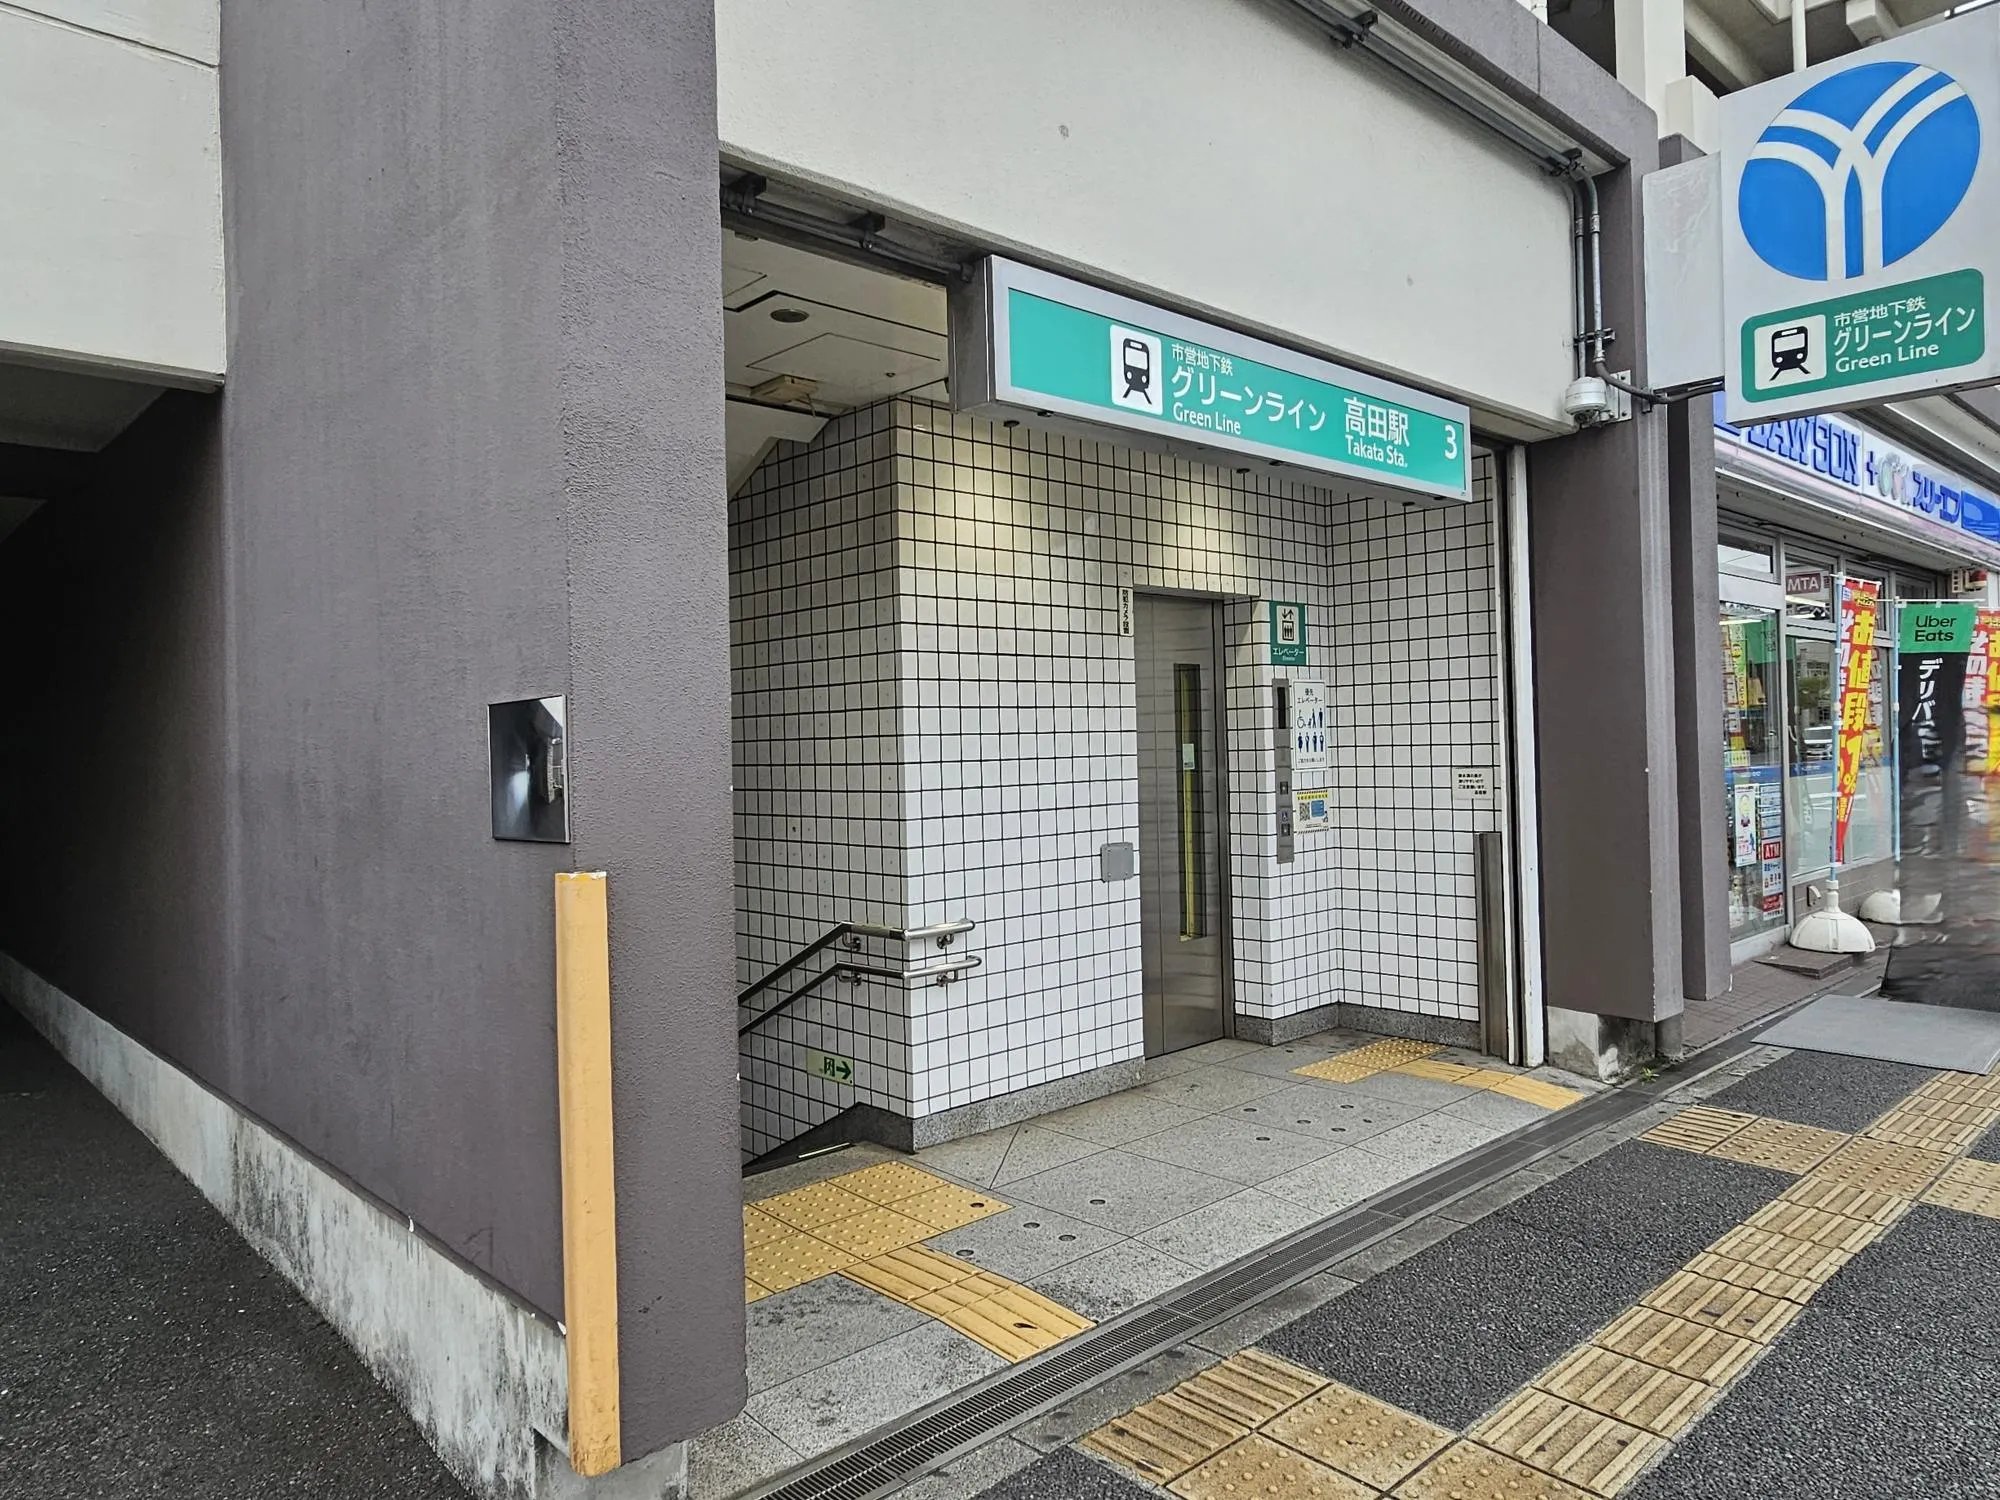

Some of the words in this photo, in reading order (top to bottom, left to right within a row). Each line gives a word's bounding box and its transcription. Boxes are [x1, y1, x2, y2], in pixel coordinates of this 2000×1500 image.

[1834, 296, 1926, 327] 市営地下鉄
[1834, 307, 1975, 356] グリーンライン
[1171, 343, 1233, 376] 市営地下鉄
[1836, 353, 1892, 373] Green
[1898, 344, 1940, 361] Line
[1171, 365, 1326, 431] グリーンライン
[1344, 397, 1410, 447] 高田駅
[1444, 424, 1458, 460] 3
[1173, 402, 1212, 428] Green
[1215, 412, 1242, 435] Line
[1345, 434, 1384, 463] Takata
[1386, 445, 1408, 468] Sta.
[1914, 629, 1955, 642] Eats
[1916, 615, 1957, 628] Uber
[1272, 647, 1304, 657] エレベーター
